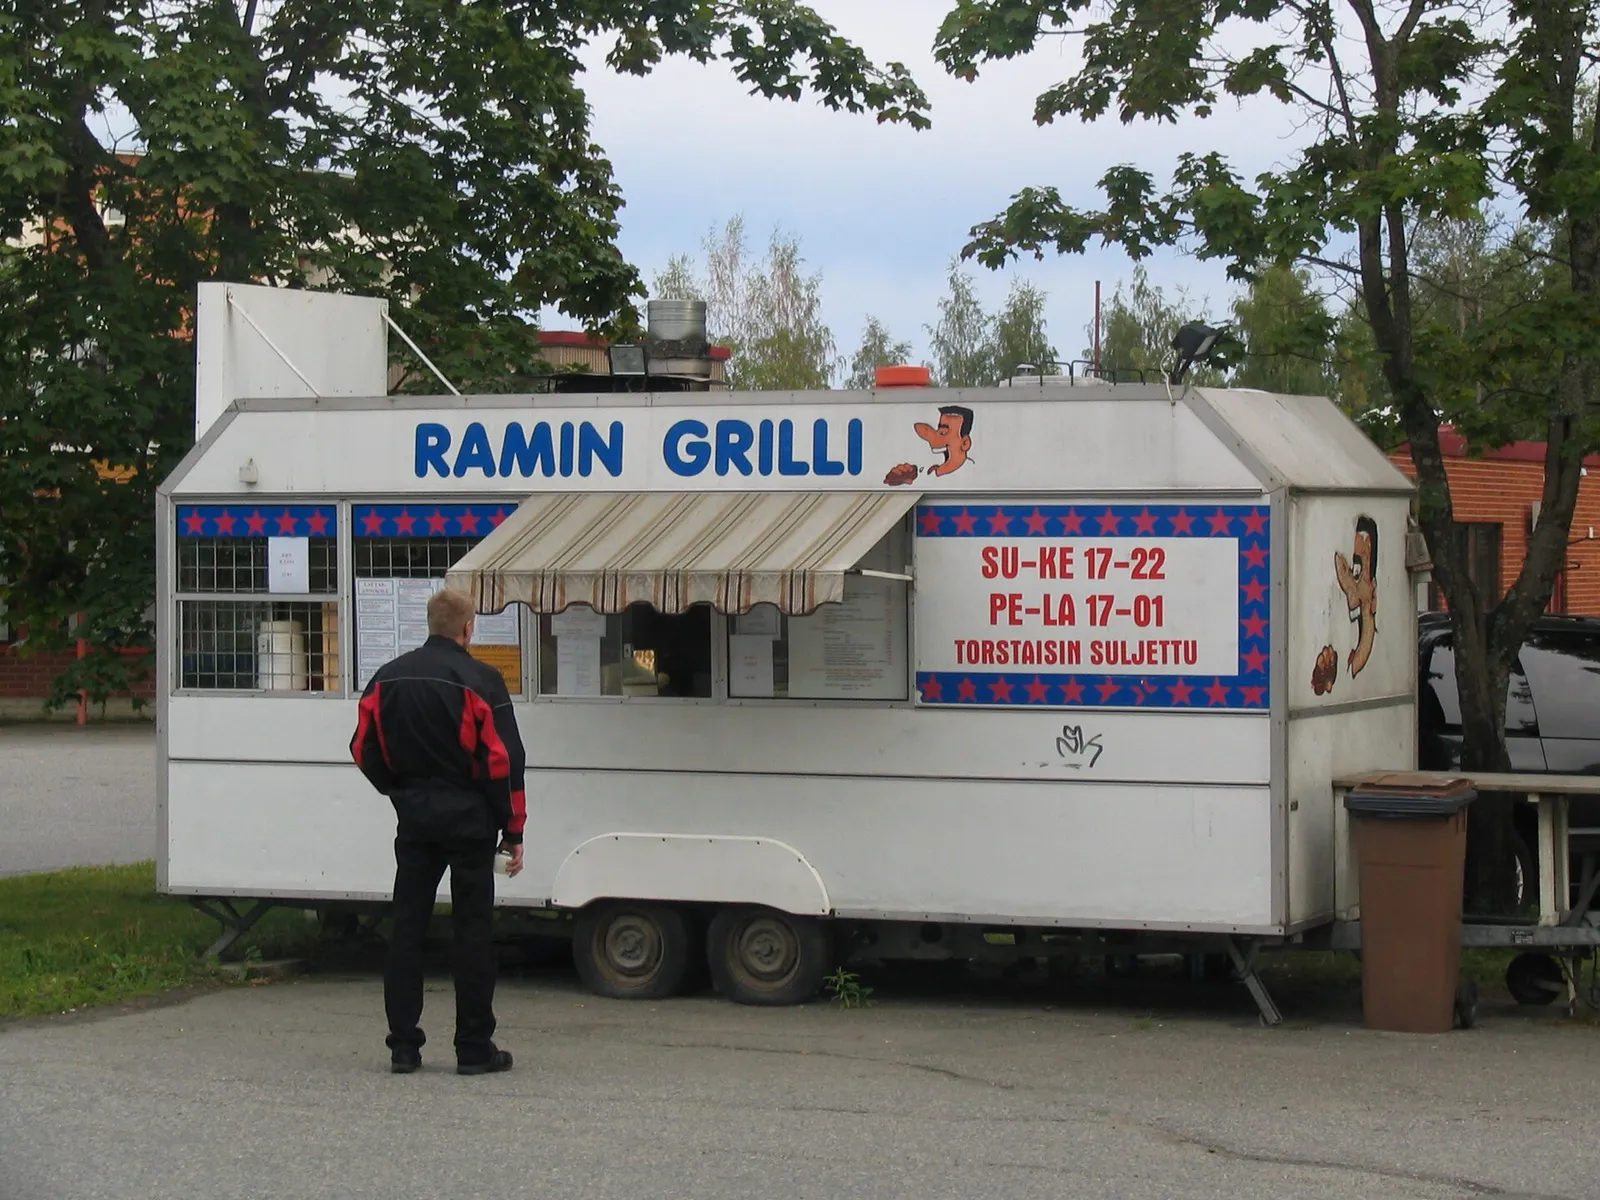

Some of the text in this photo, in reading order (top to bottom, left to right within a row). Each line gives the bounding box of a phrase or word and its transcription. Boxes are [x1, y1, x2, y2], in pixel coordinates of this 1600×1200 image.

[415, 418, 863, 477] RAMIN GRILLI
[981, 546, 1166, 581] SU-KE 17-22
[989, 594, 1164, 628] PE-LA 17-01
[954, 639, 1198, 666] TORSTAISIN SULJETTU
